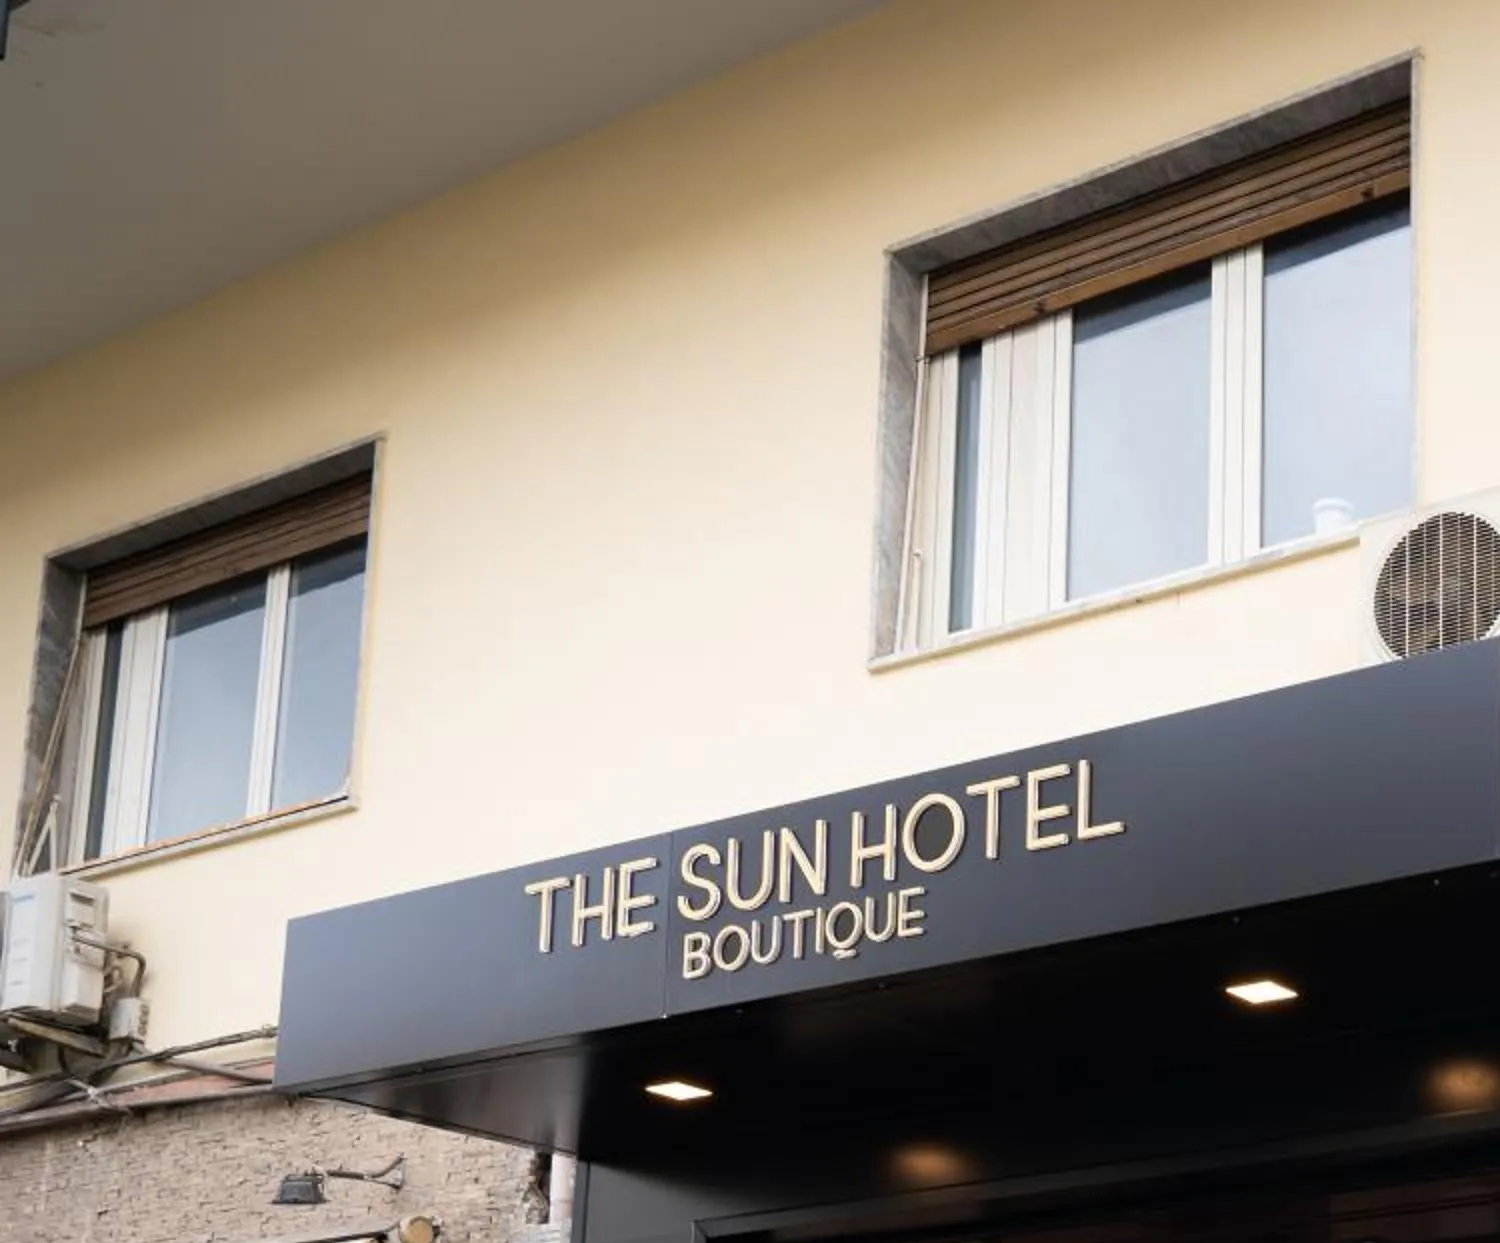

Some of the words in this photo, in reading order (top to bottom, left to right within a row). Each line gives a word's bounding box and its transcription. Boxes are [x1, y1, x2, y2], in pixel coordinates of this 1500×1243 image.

[524, 856, 658, 954] THE
[677, 818, 829, 922] SUN
[849, 758, 1127, 889] HOTEL
[682, 886, 927, 980] BOUTIQUE
